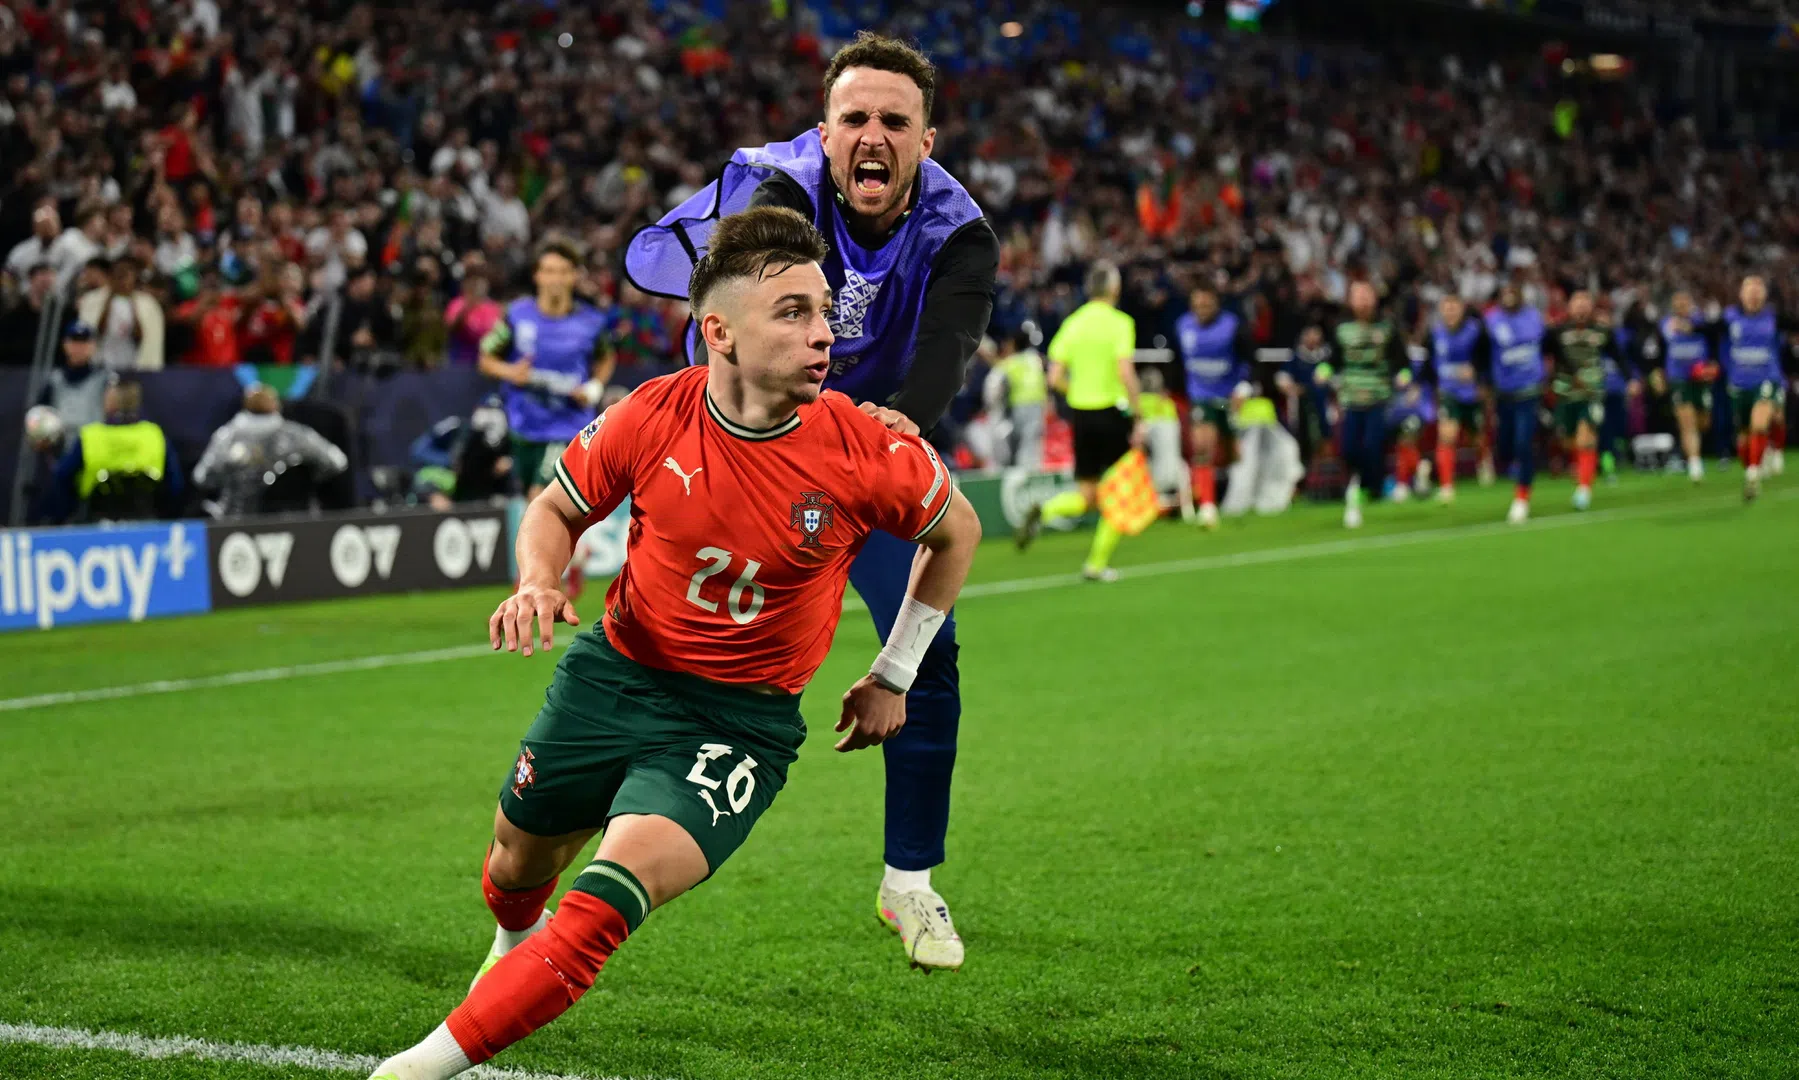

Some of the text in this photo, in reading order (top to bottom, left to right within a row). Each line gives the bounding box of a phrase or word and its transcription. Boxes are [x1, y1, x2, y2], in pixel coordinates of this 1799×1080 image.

[0, 523, 195, 629] lipay+
[686, 546, 765, 625] 26
[685, 743, 758, 814] 26
